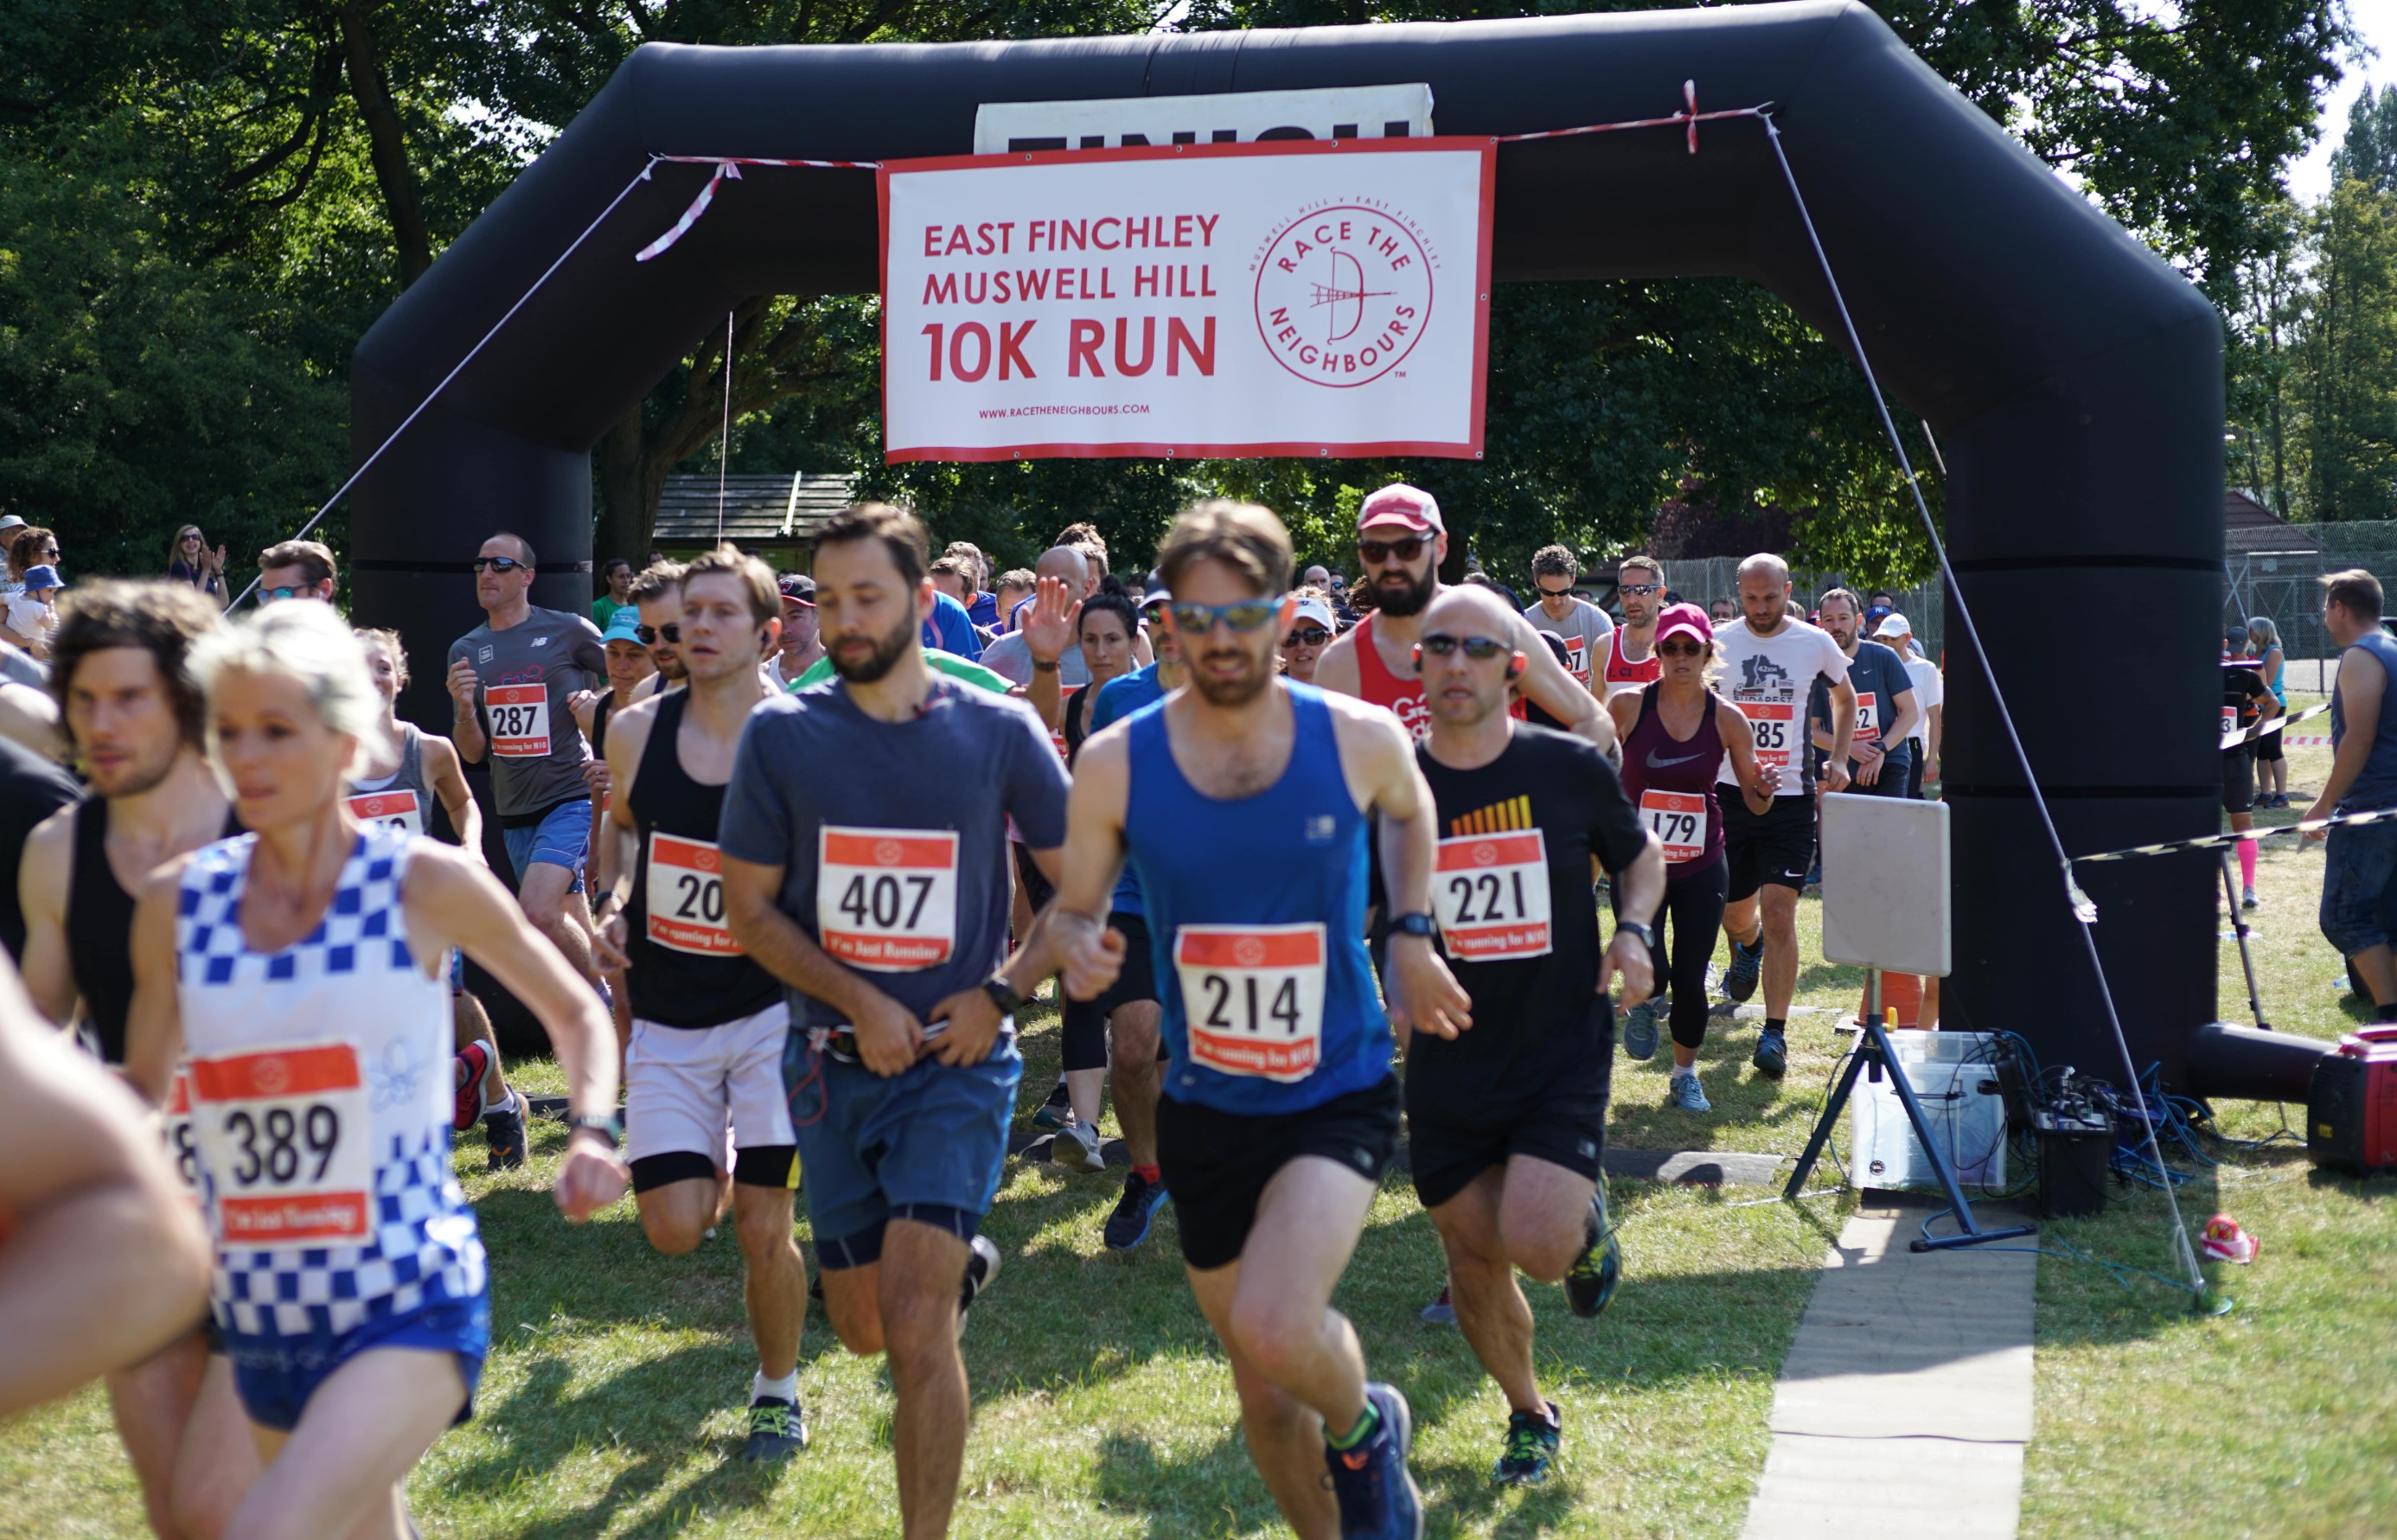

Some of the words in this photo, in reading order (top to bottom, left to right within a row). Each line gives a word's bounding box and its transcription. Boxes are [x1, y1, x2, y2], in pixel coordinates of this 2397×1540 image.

[1298, 198, 1328, 215] HILL
[1356, 195, 1390, 209] EAST
[924, 222, 1015, 257] EAST
[1028, 214, 1220, 252] FINCHLEY
[1277, 221, 1352, 273] RACE
[1367, 227, 1411, 272] THE
[923, 267, 1115, 305] MUSWELL
[1135, 265, 1217, 297] HILL
[921, 319, 1038, 383] 10K
[1068, 316, 1217, 378] RUN
[1269, 304, 1416, 374] NEIGHBOURS
[979, 404, 1150, 419] WWW.RACETHENEIGHBOURS.COM
[492, 706, 538, 737] 287
[1653, 812, 1697, 843] 179
[840, 874, 936, 930] 407
[1449, 871, 1526, 924] 221
[854, 940, 882, 958] Just
[1204, 974, 1301, 1034] 214
[226, 1104, 341, 1190] 389
